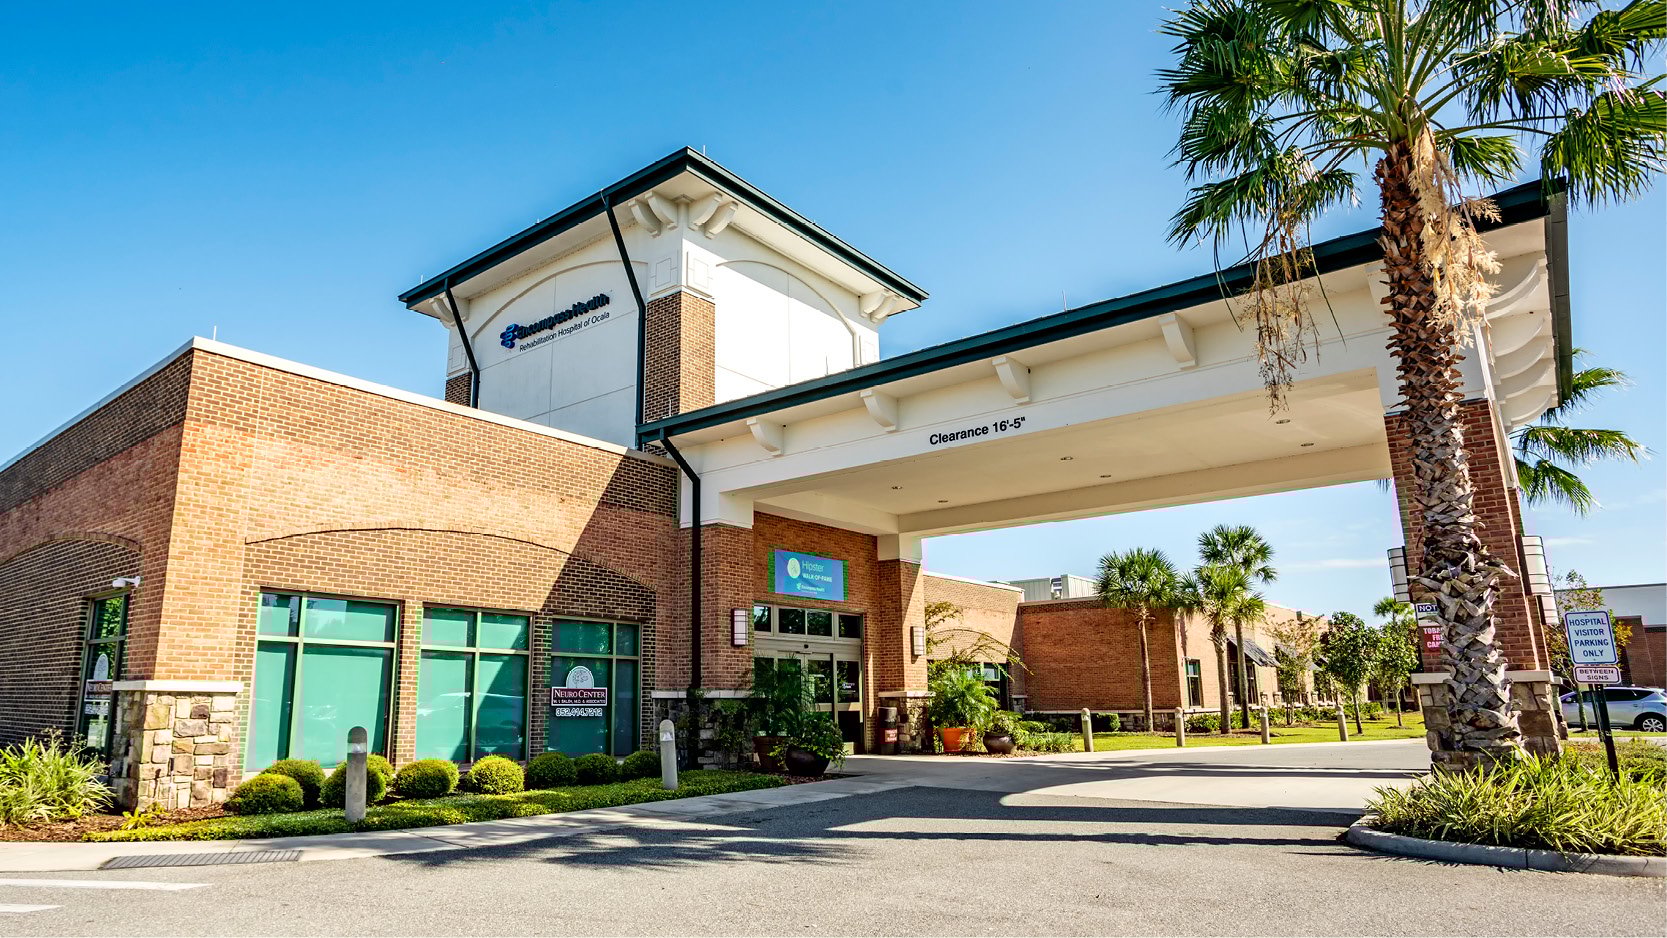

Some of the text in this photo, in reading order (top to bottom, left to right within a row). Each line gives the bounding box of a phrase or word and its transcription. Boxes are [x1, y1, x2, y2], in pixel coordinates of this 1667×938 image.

[516, 293, 610, 339] Encompass Health
[520, 311, 610, 352] Rehabilitation Hospital of Ocala
[929, 416, 1026, 445] Clearance 16'-5"
[802, 561, 824, 572] Hipster
[1569, 618, 1606, 626] HOSPITAL
[1575, 628, 1605, 636] VISITOR
[1574, 639, 1609, 647] PARKING
[554, 689, 606, 698] NEURO CENTER
